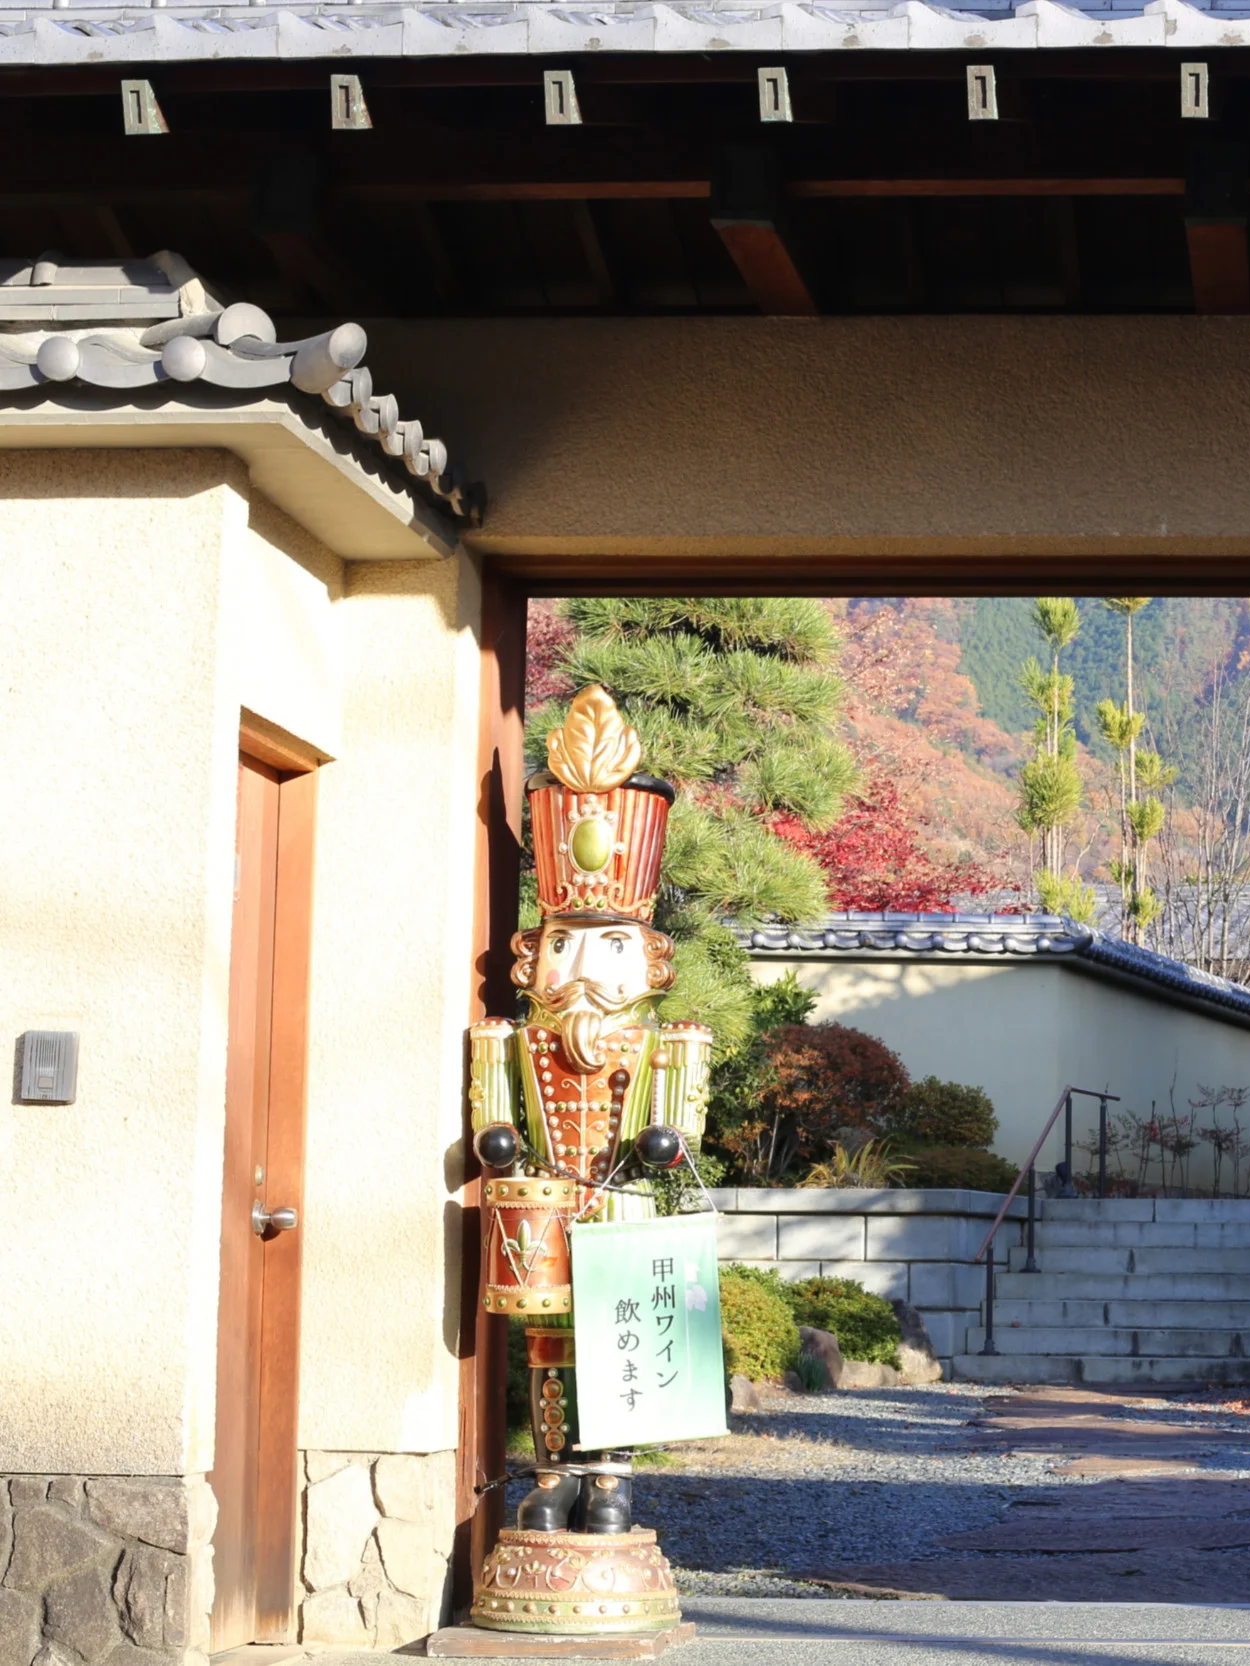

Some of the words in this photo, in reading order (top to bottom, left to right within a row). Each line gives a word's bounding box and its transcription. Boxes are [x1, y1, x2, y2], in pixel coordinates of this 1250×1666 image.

[614, 1298, 644, 1412] 飲めます
[651, 1257, 678, 1388] 甲州ワイン
